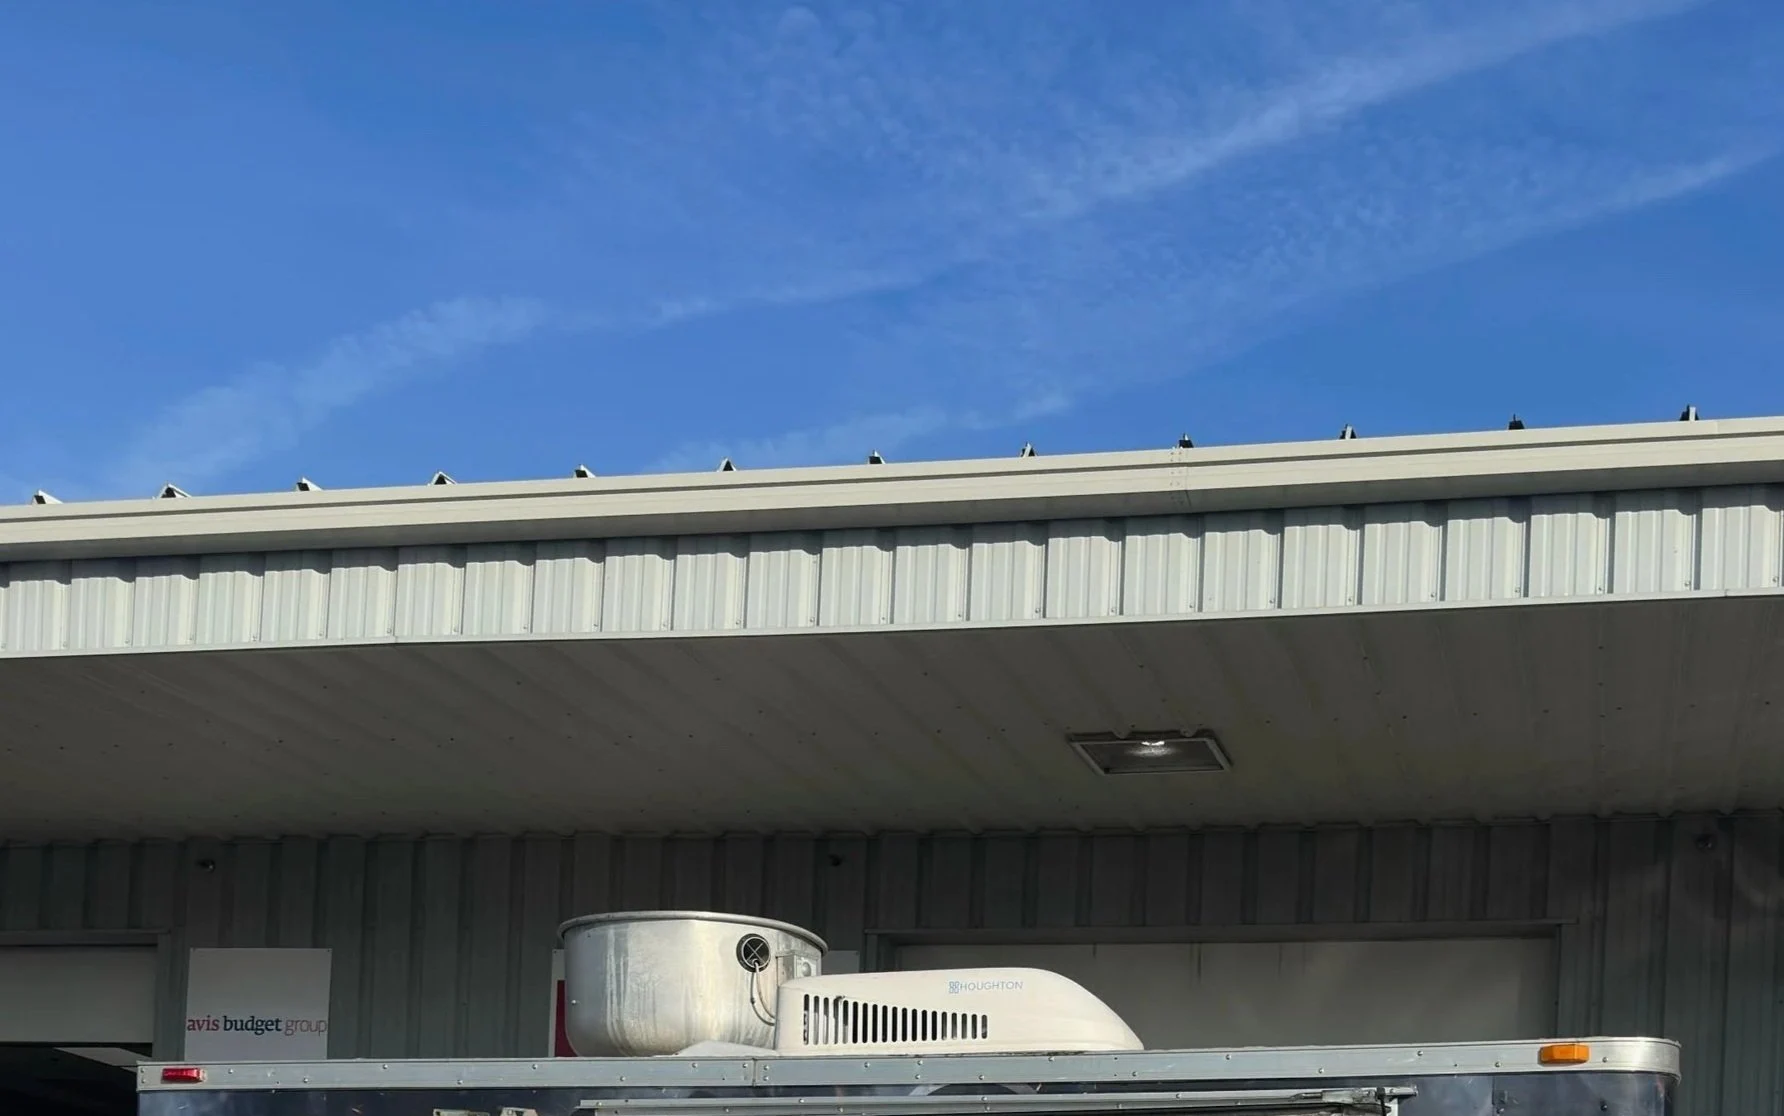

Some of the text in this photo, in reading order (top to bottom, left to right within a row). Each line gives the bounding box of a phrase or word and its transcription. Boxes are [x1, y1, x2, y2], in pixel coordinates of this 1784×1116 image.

[960, 981, 1024, 991] HOUGHTON
[186, 1015, 328, 1036] avis budget group
